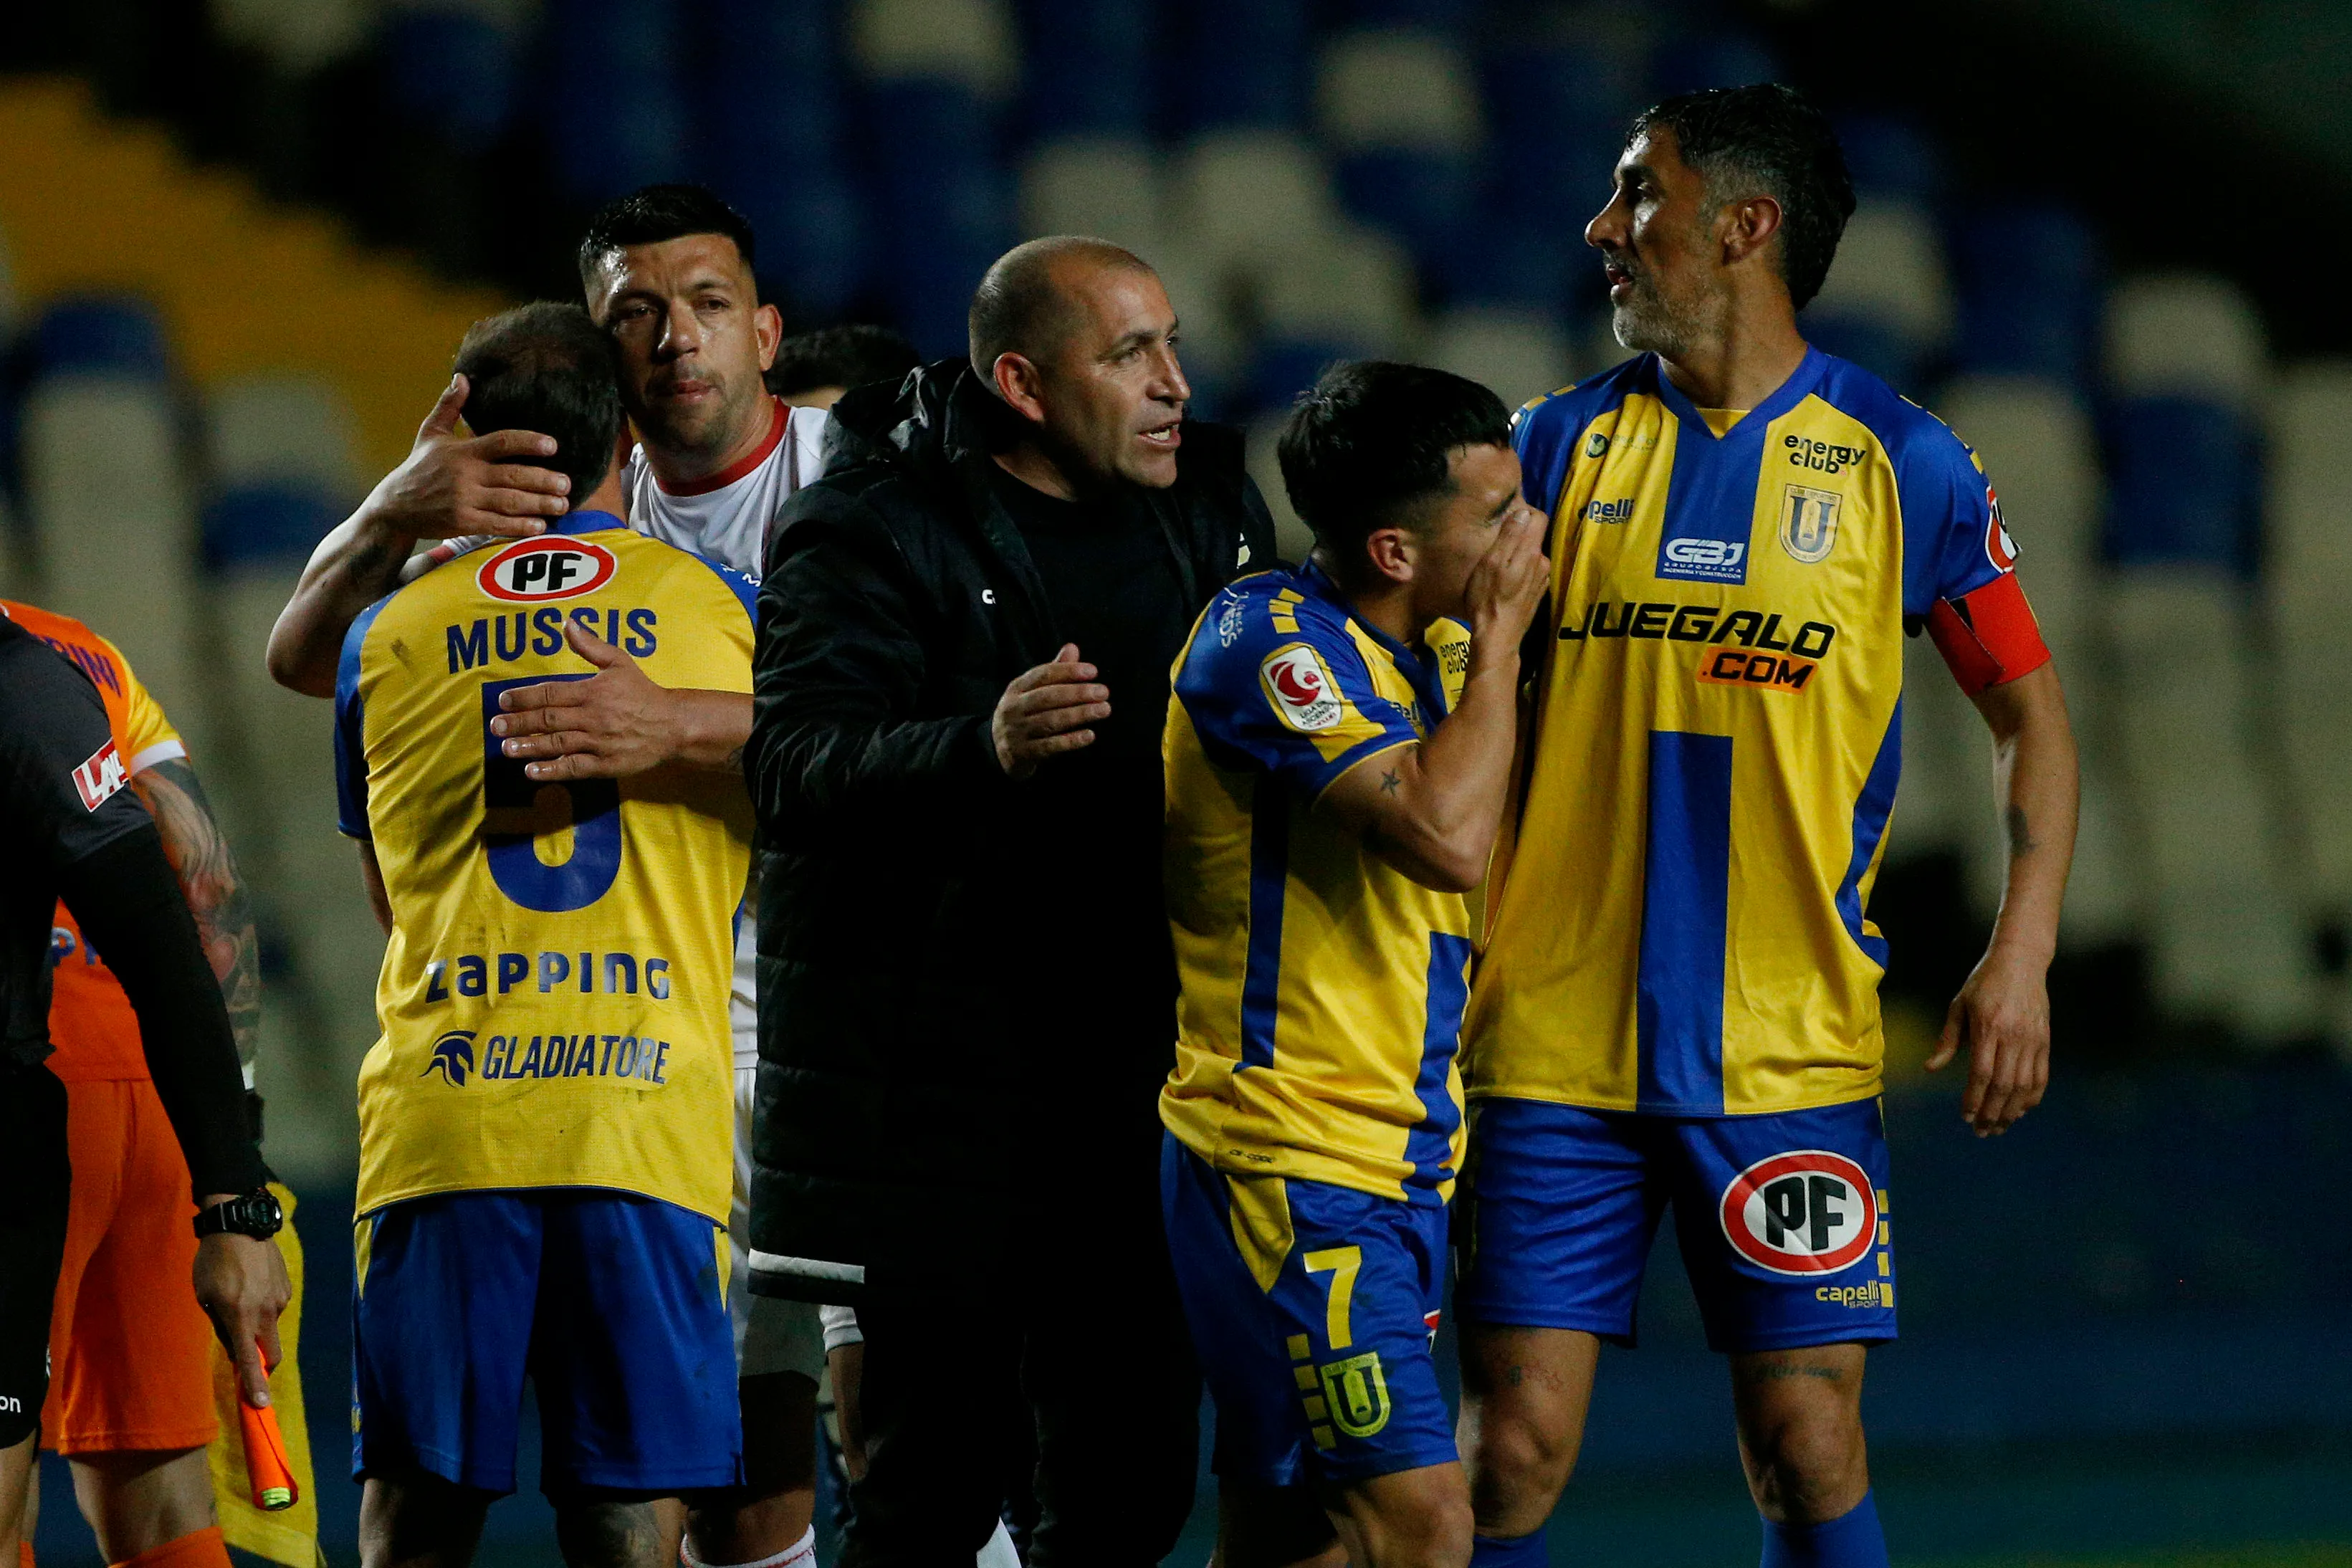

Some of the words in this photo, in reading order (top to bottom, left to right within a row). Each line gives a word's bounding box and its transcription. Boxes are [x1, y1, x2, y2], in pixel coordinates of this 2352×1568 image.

[1784, 435, 1867, 466] energy
[512, 553, 582, 592] PF
[1559, 602, 1836, 659] JUEGALO
[482, 1034, 670, 1084] GLADIATORE
[1764, 1175, 1847, 1251] PF
[1303, 1245, 1362, 1349] 7
[1815, 1280, 1879, 1306] capelli
